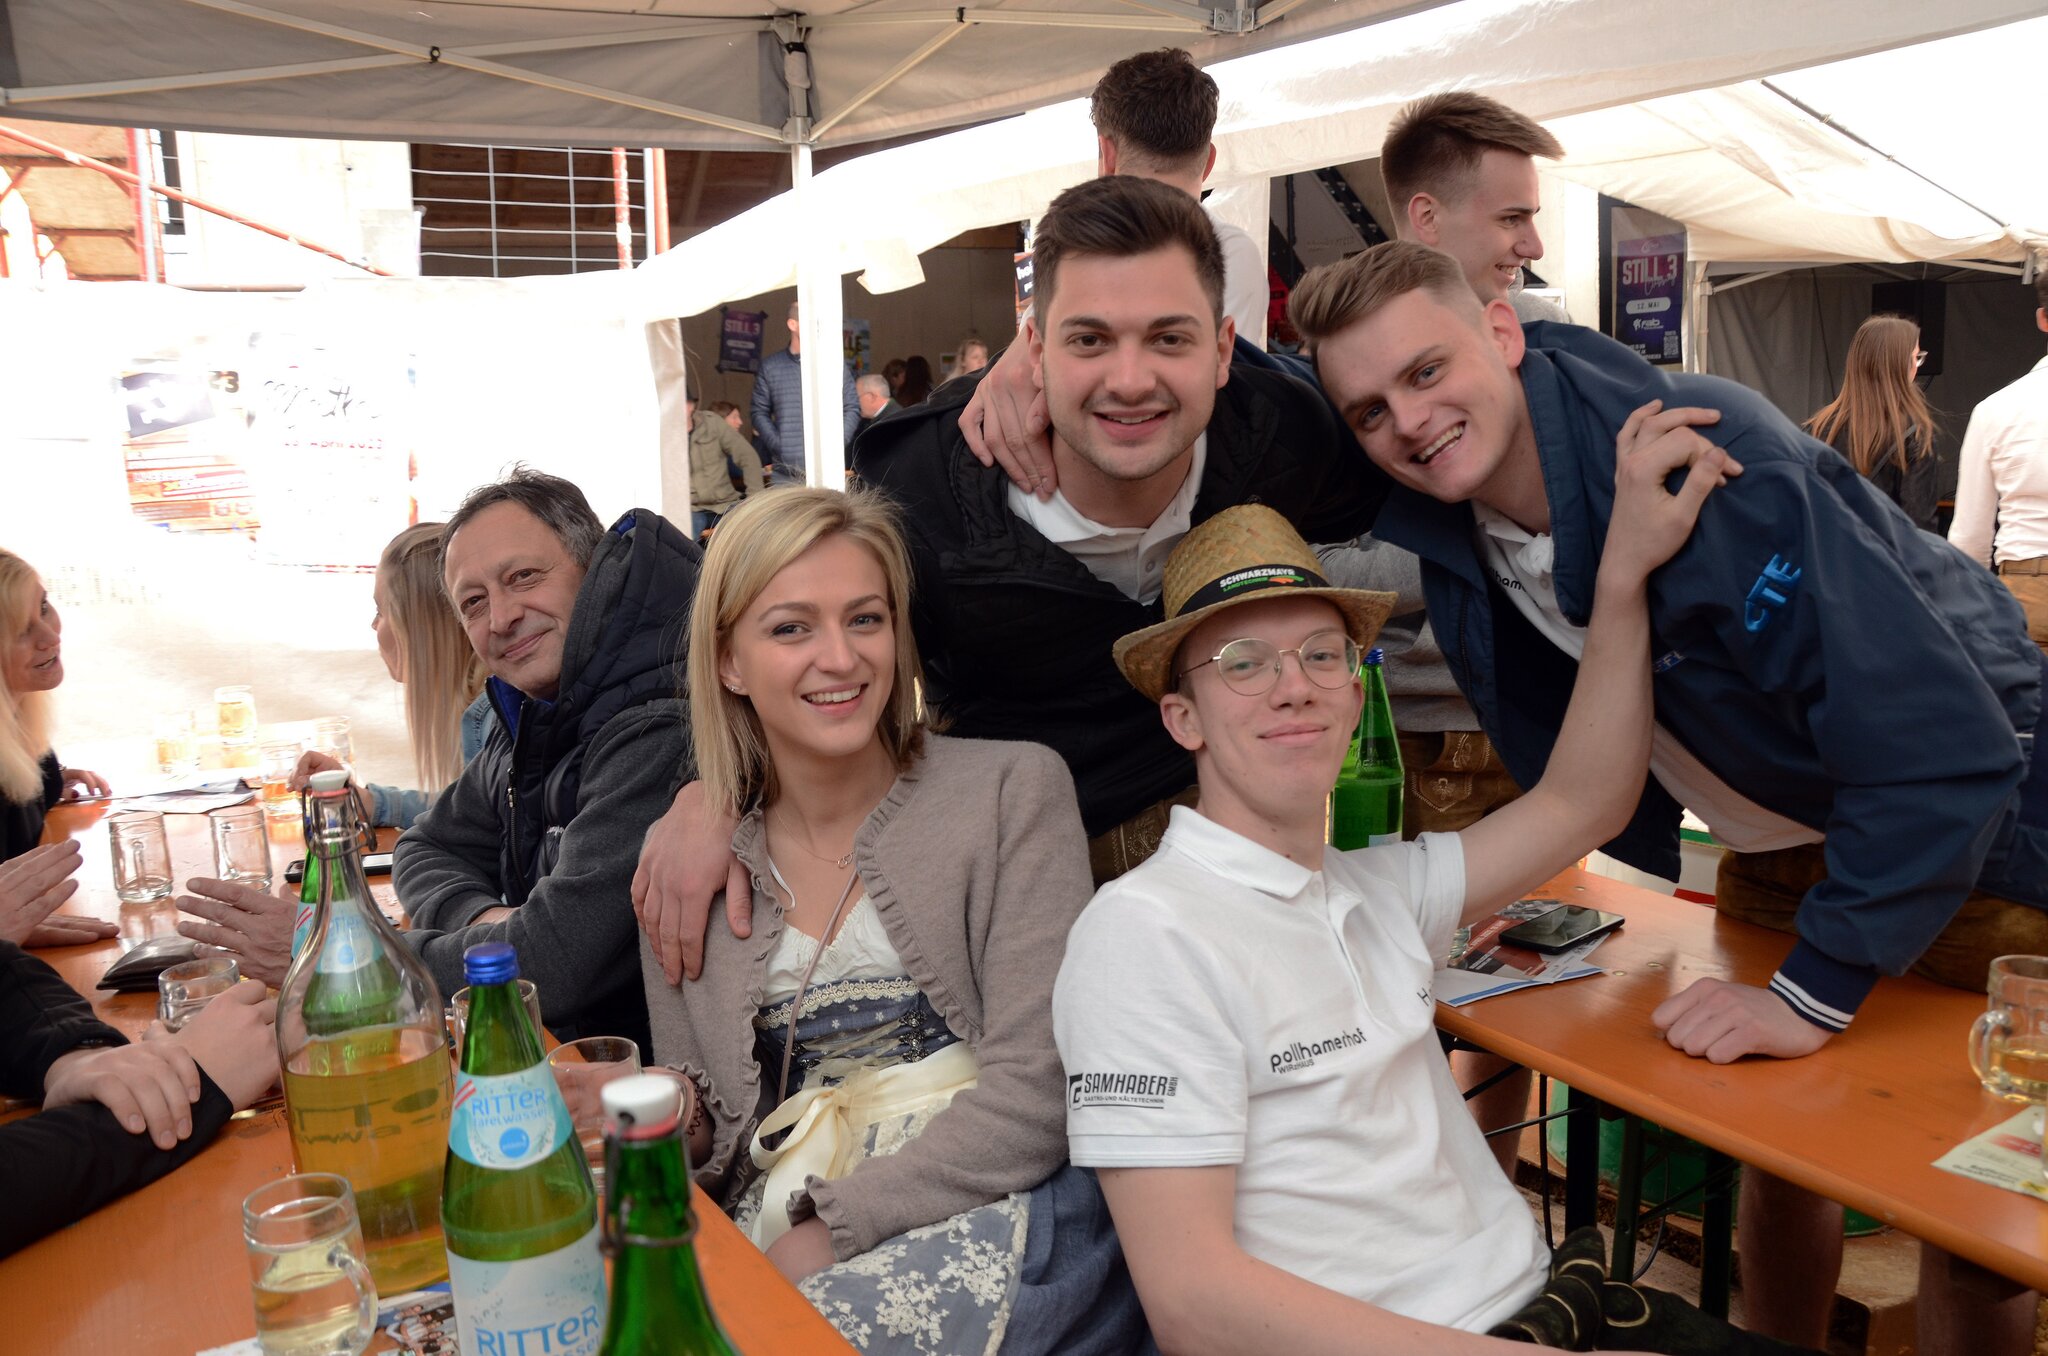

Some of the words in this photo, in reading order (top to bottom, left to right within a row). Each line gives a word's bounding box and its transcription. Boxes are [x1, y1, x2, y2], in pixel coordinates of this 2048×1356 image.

[1622, 255, 1664, 285] STILL
[1667, 254, 1678, 281] 3
[1220, 567, 1296, 588] SCHWARZMAYR
[1270, 1027, 1367, 1073] pollhamerhof
[1084, 1073, 1168, 1096] SAMHABER
[1167, 1076, 1179, 1097] GMBH
